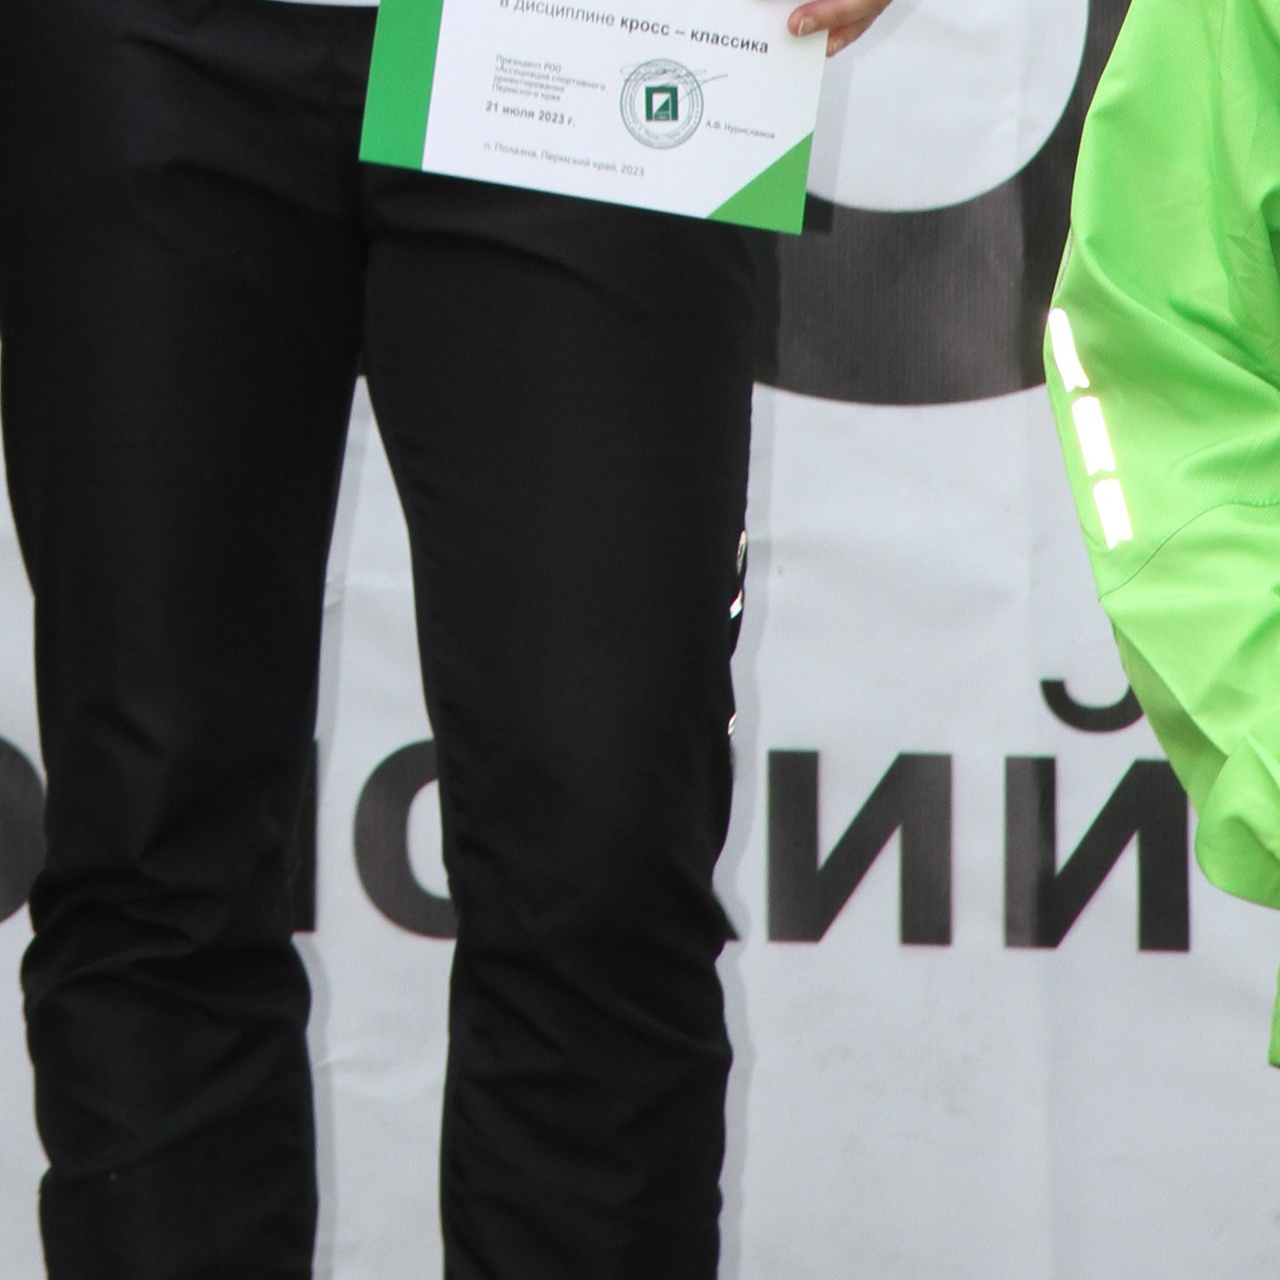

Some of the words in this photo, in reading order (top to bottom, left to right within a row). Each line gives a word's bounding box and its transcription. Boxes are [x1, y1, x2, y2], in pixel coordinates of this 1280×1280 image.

[620, 14, 671, 39] кросс
[690, 28, 769, 55] классика
[486, 100, 498, 112] 21
[502, 106, 534, 119] июля
[538, 110, 564, 125] 2023
[621, 164, 645, 177] 2023
